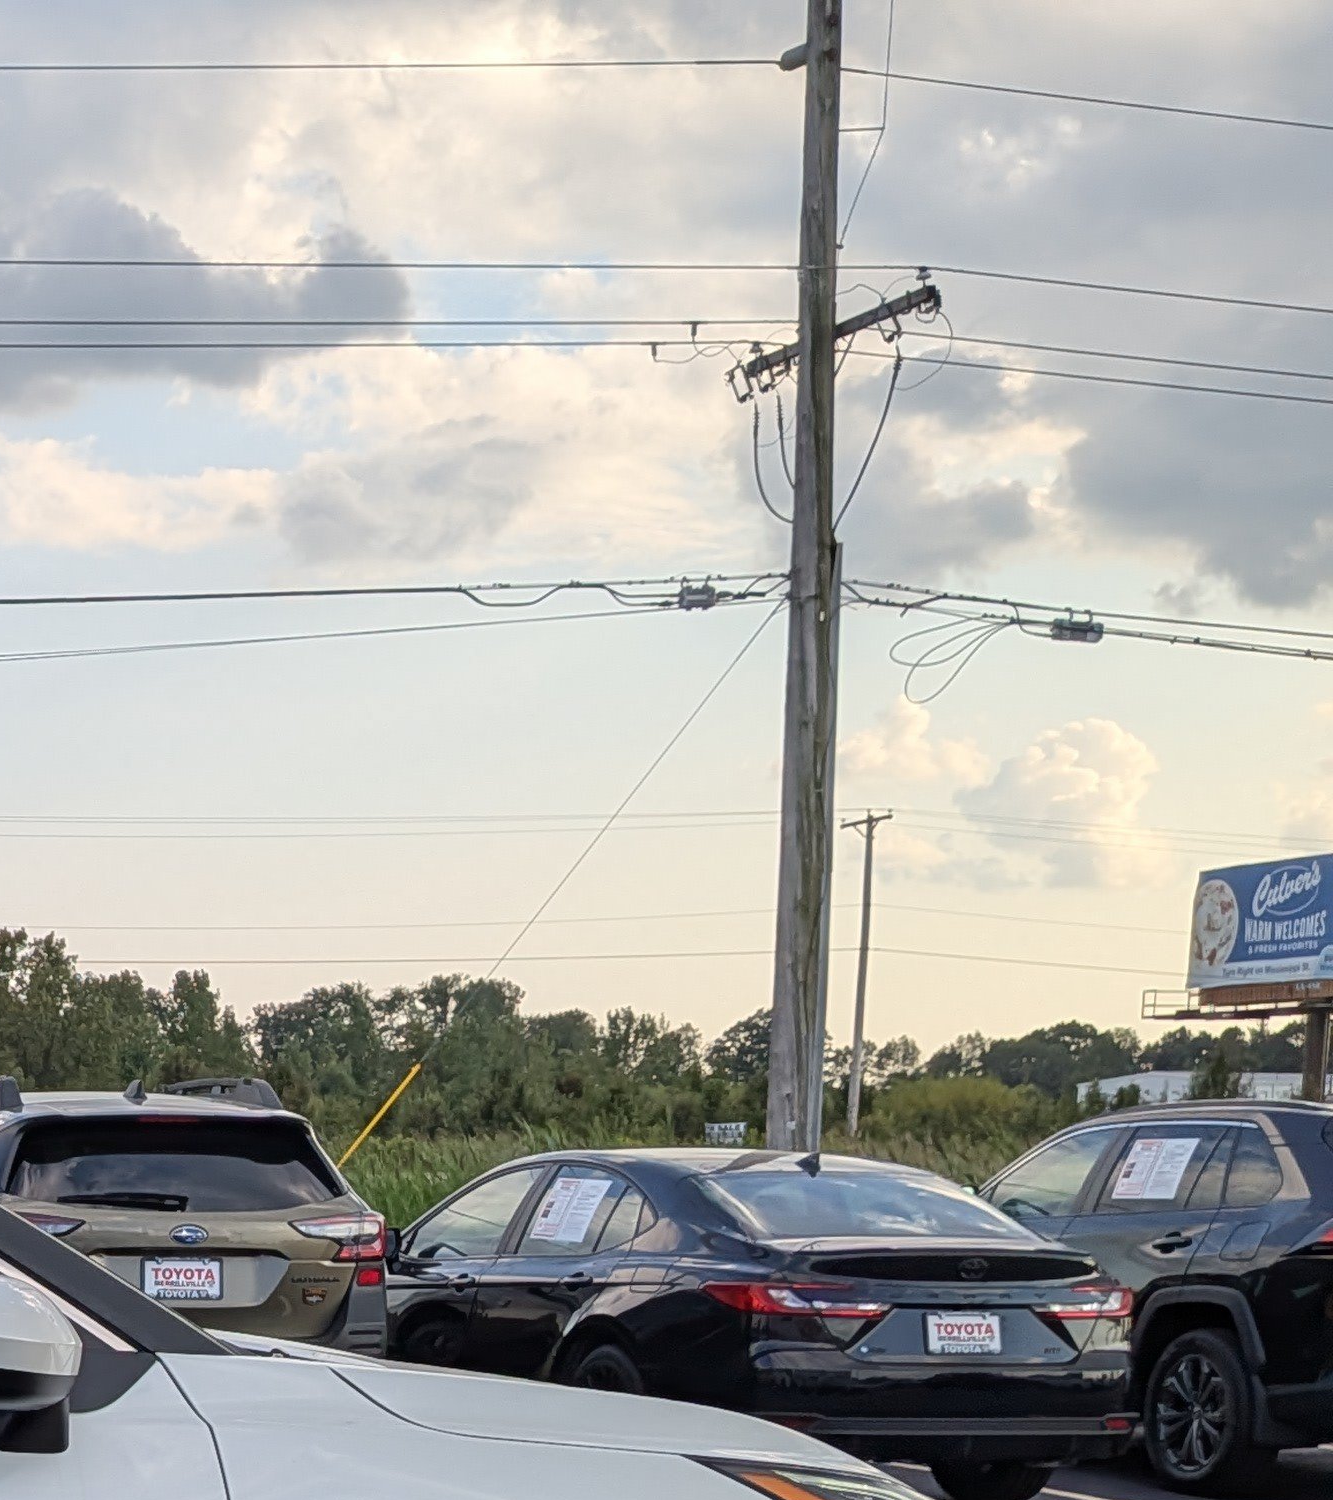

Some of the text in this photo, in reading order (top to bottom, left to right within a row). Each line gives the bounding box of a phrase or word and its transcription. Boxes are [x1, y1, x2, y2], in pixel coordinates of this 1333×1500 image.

[1252, 860, 1321, 917] Culver's
[1245, 910, 1326, 942] WARM WELCOMES
[151, 1268, 215, 1280] TOYOTA
[159, 1290, 199, 1298] TOYOTA
[935, 1323, 995, 1335] TOYOTA
[944, 1345, 982, 1353] TOYOTA
